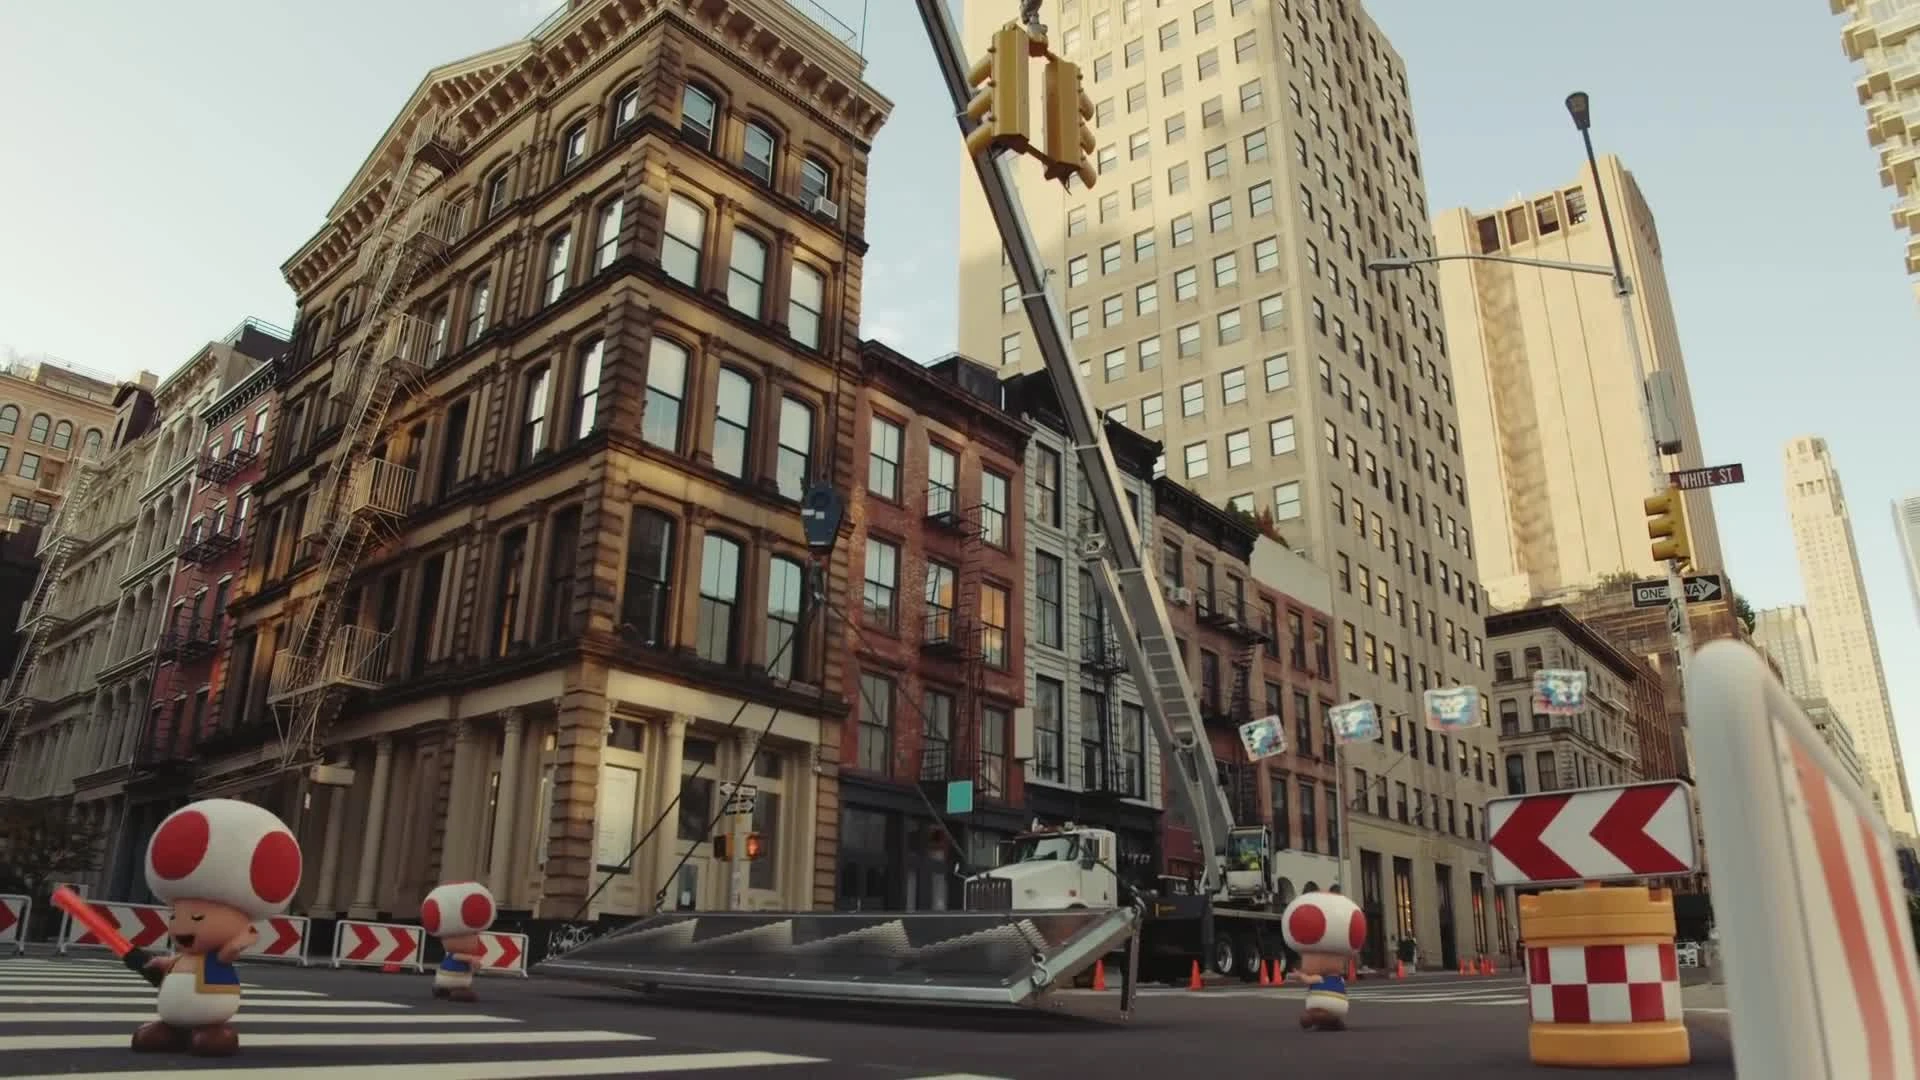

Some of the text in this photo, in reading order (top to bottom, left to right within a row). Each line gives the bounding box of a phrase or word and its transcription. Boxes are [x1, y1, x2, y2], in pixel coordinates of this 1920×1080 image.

[1679, 468, 1733, 488] WHITE ST
[1640, 588, 1665, 599] ONE
